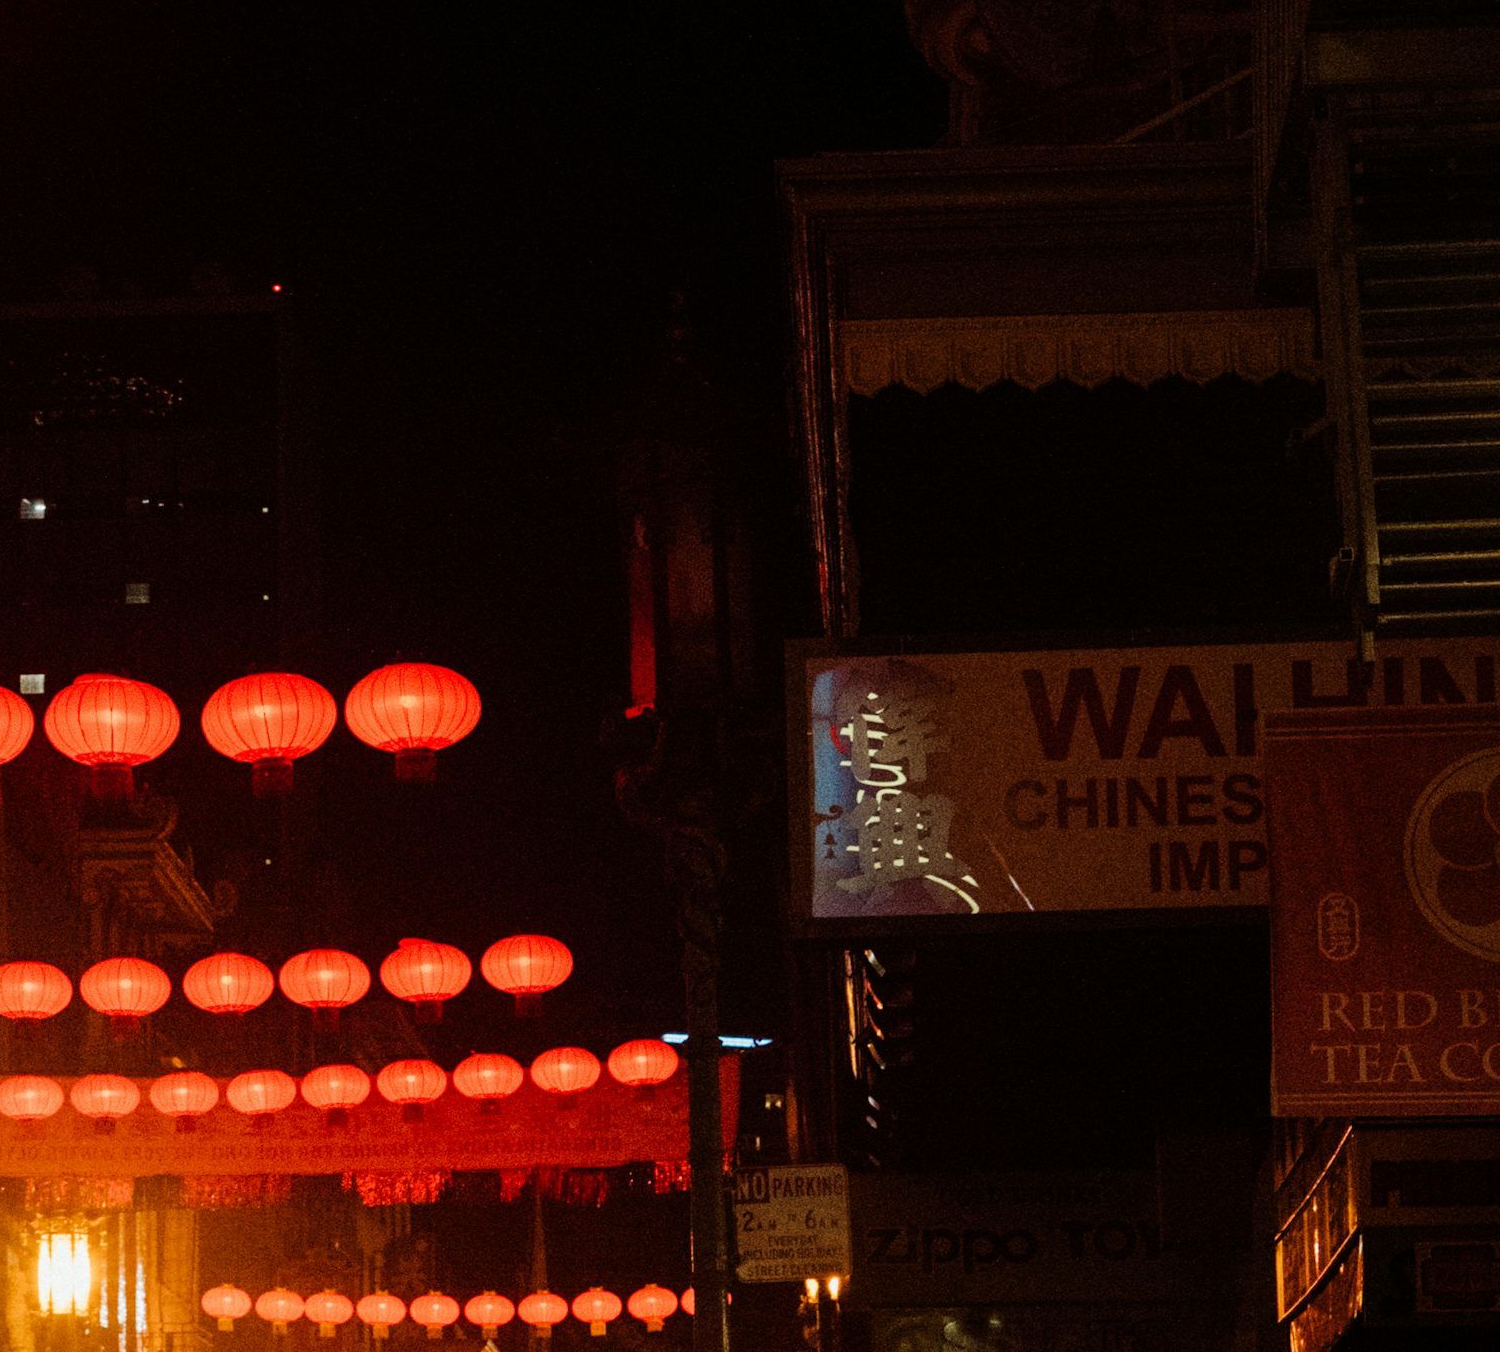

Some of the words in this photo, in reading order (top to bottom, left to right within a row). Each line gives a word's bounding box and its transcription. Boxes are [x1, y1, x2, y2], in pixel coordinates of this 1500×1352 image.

[1022, 661, 1256, 761] WAI
[1006, 773, 1264, 831] CHINES
[1149, 841, 1267, 893] IMP
[1317, 991, 1438, 1032] RED
[1458, 989, 1500, 1029] B
[1309, 1042, 1427, 1084] TEA
[736, 1171, 767, 1201] NO
[772, 1174, 844, 1199] PARKING
[866, 1223, 1038, 1274] zippo
